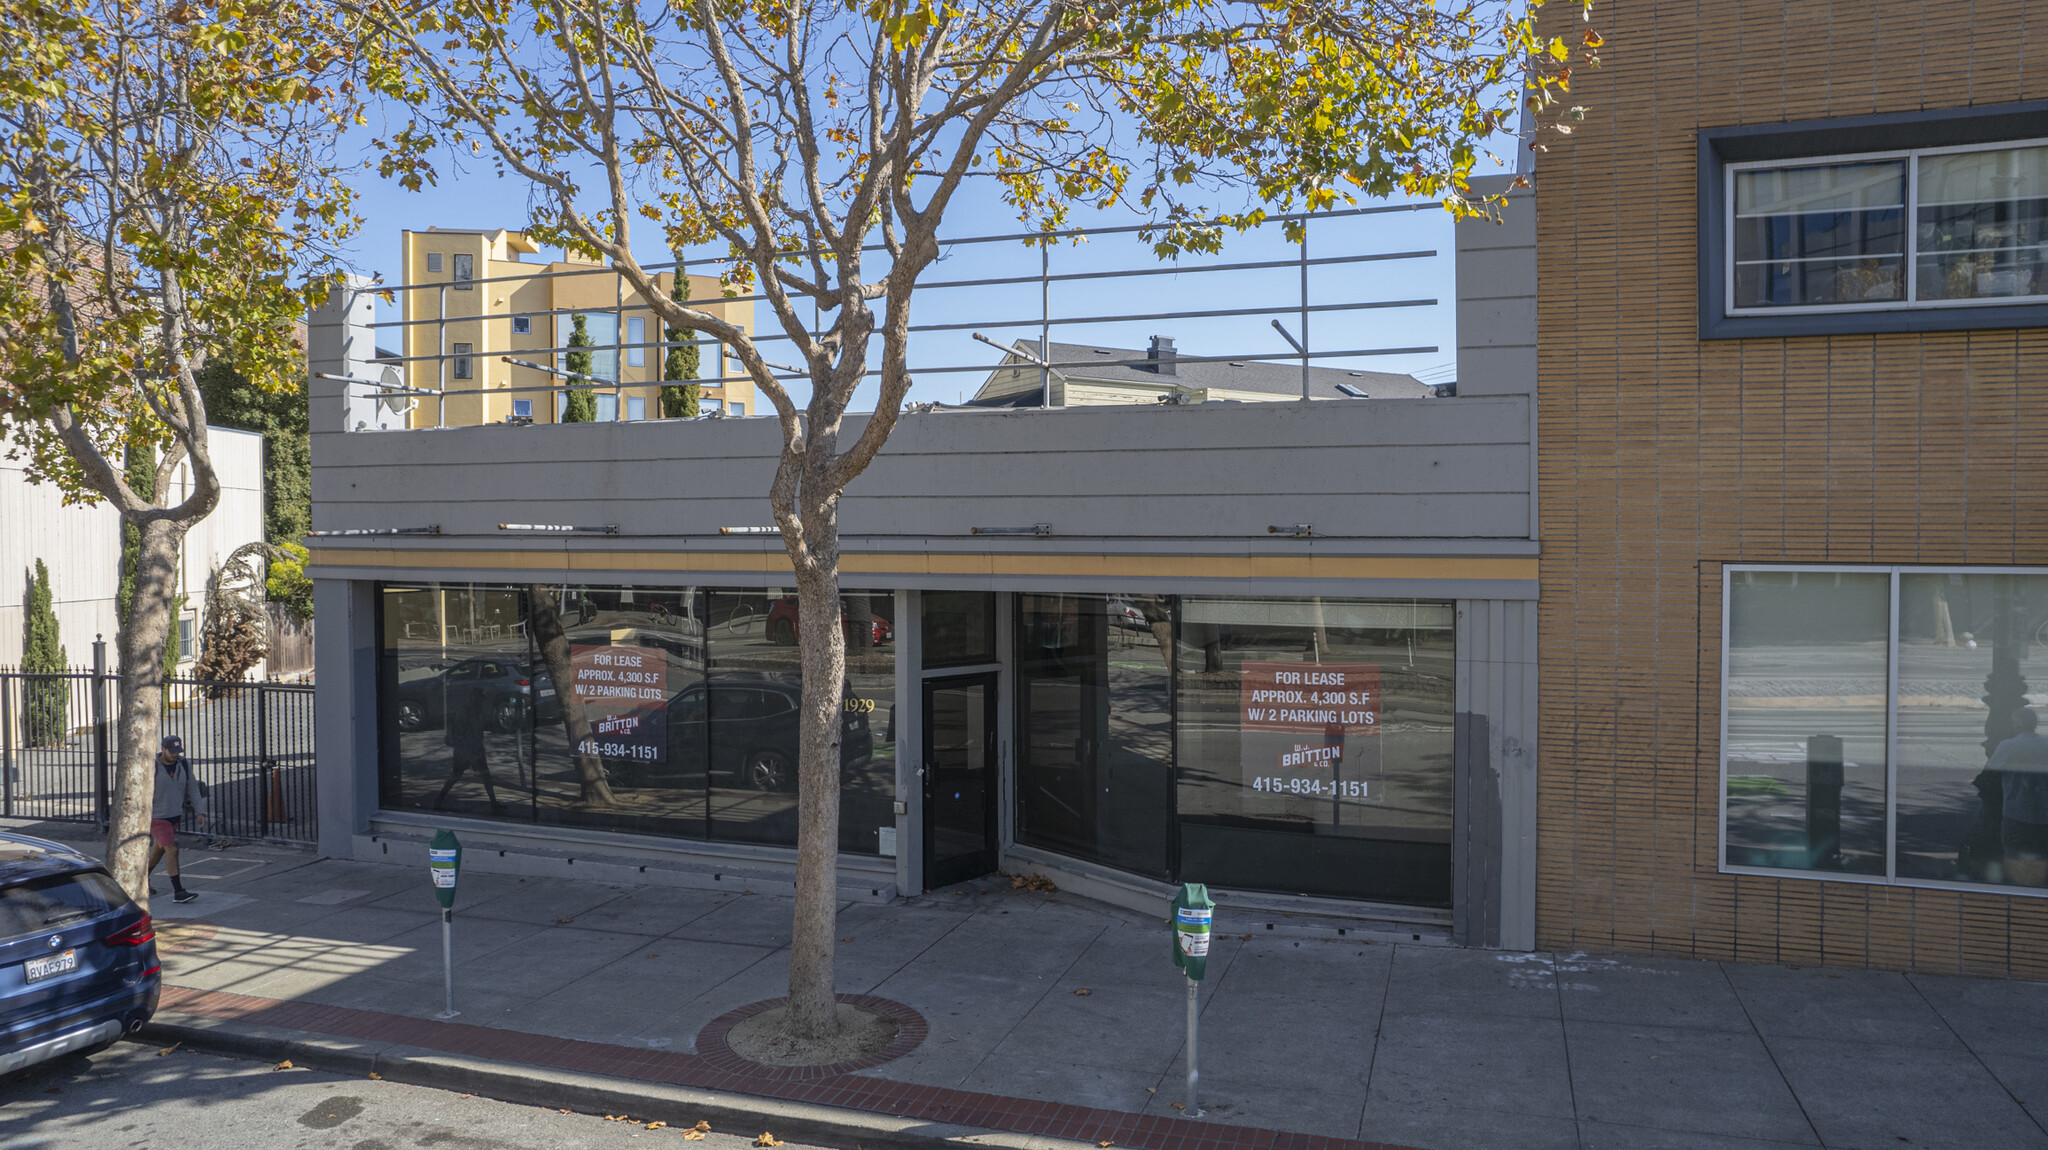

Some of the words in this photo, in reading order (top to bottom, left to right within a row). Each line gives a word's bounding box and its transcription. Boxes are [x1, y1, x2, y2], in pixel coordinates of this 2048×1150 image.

[594, 654, 611, 666] FOR
[614, 655, 642, 667] LEASE
[578, 669, 616, 680] APPROX.
[618, 671, 643, 684] 4,300
[644, 673, 659, 684] S.F
[1275, 671, 1300, 685] FOR
[1304, 672, 1345, 686] LEASE
[575, 684, 587, 695] W/
[589, 685, 596, 696] 2
[597, 686, 637, 698] PARKING
[639, 688, 662, 700] LOTS
[1252, 690, 1307, 704] APPROX.
[1310, 691, 1346, 706] 4,300
[1349, 692, 1370, 705] S.F
[844, 698, 875, 713] 1929
[1248, 708, 1265, 721] W/
[1268, 708, 1277, 722] 2
[1280, 709, 1337, 723] PARKING
[1341, 710, 1374, 725] LOTS
[598, 717, 639, 733] BRITTON
[578, 740, 658, 760] 415-934-1151
[1282, 746, 1341, 767] BRITTON
[1252, 776, 1368, 797] 415-934-1151
